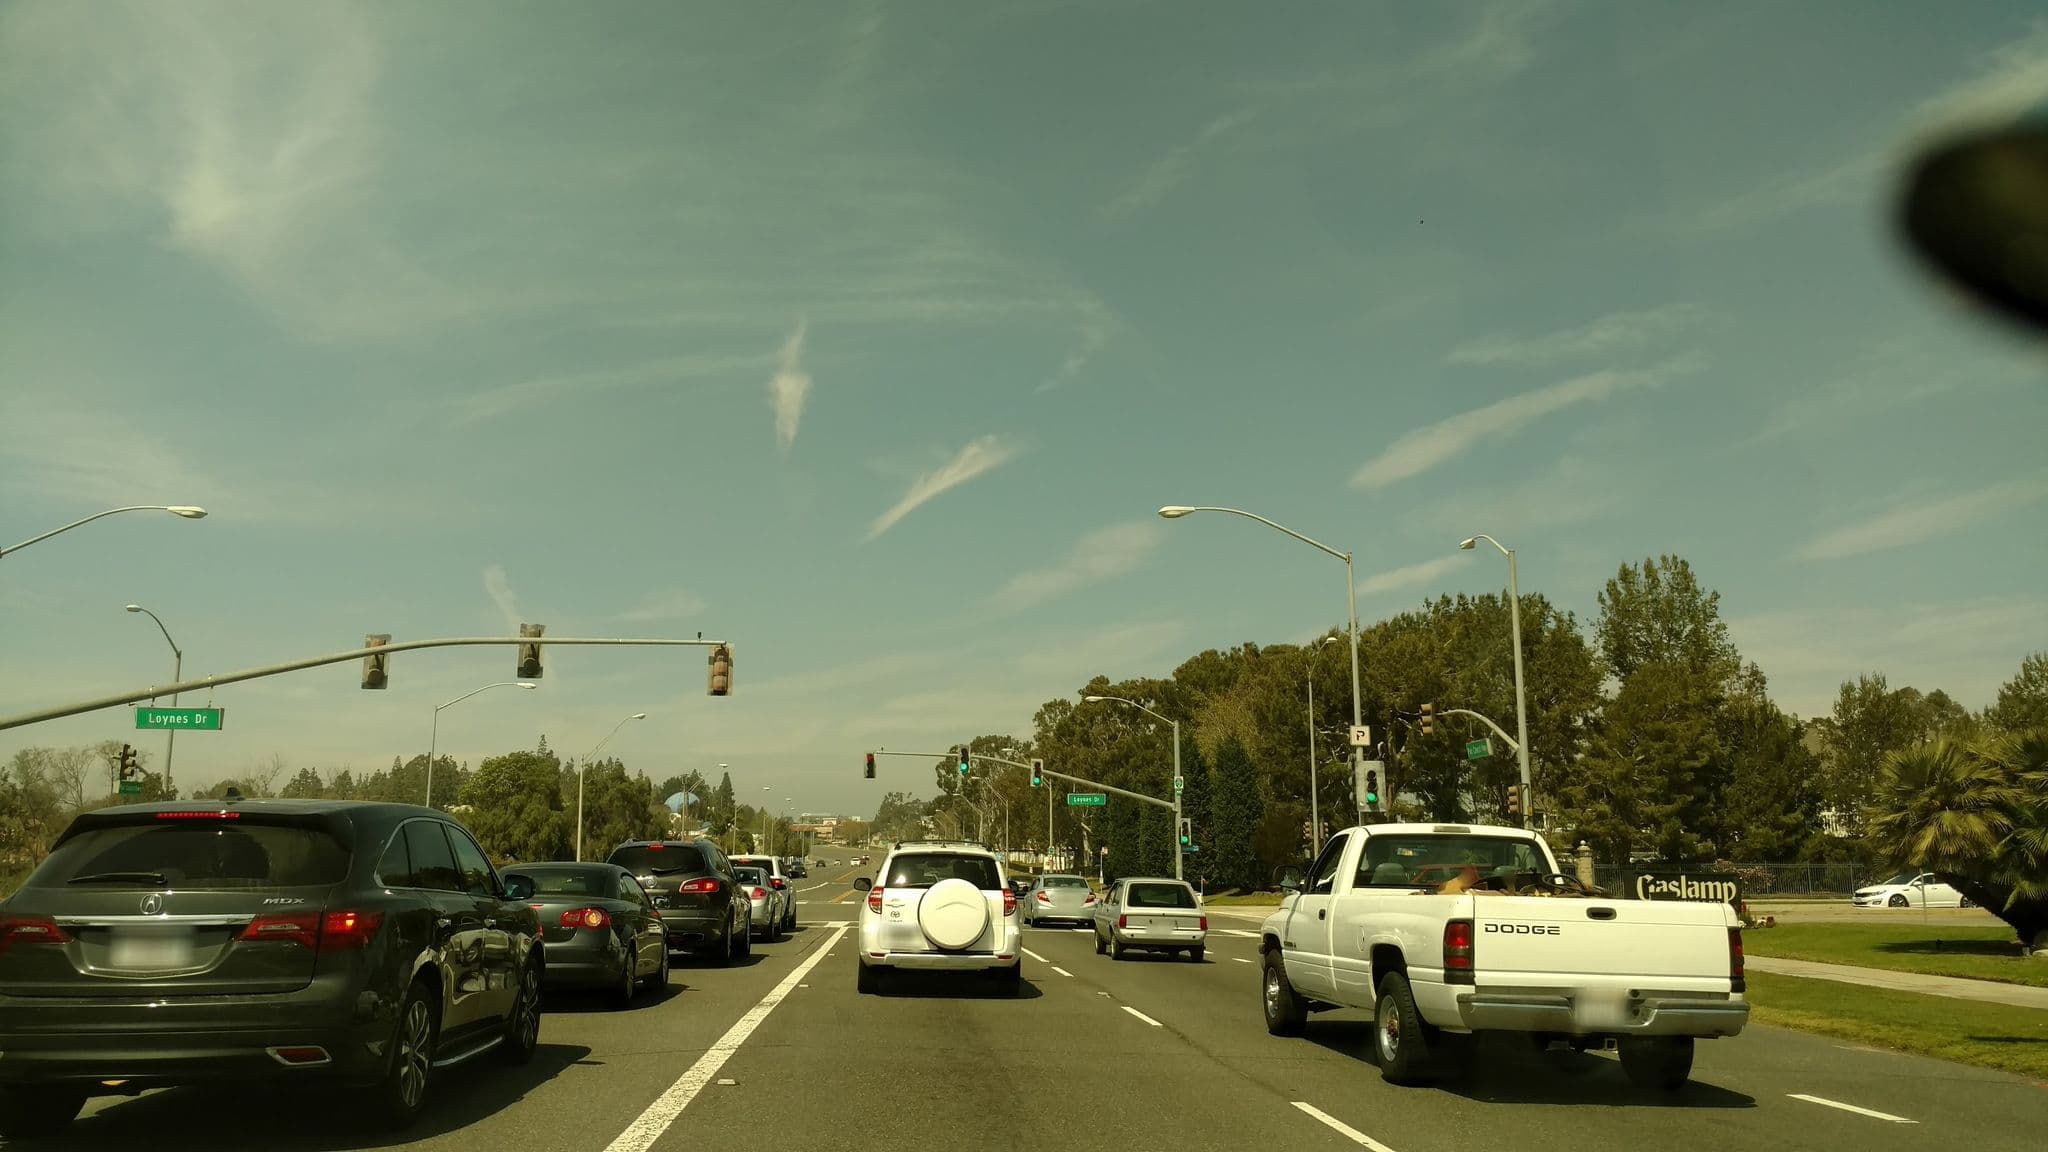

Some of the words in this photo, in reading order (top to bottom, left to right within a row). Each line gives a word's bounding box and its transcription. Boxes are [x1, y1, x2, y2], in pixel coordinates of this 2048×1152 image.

[148, 713, 189, 725] Loynes
[195, 713, 208, 724] Dr
[1636, 874, 1737, 904] Gaslamp
[1484, 923, 1561, 936] DODGE
